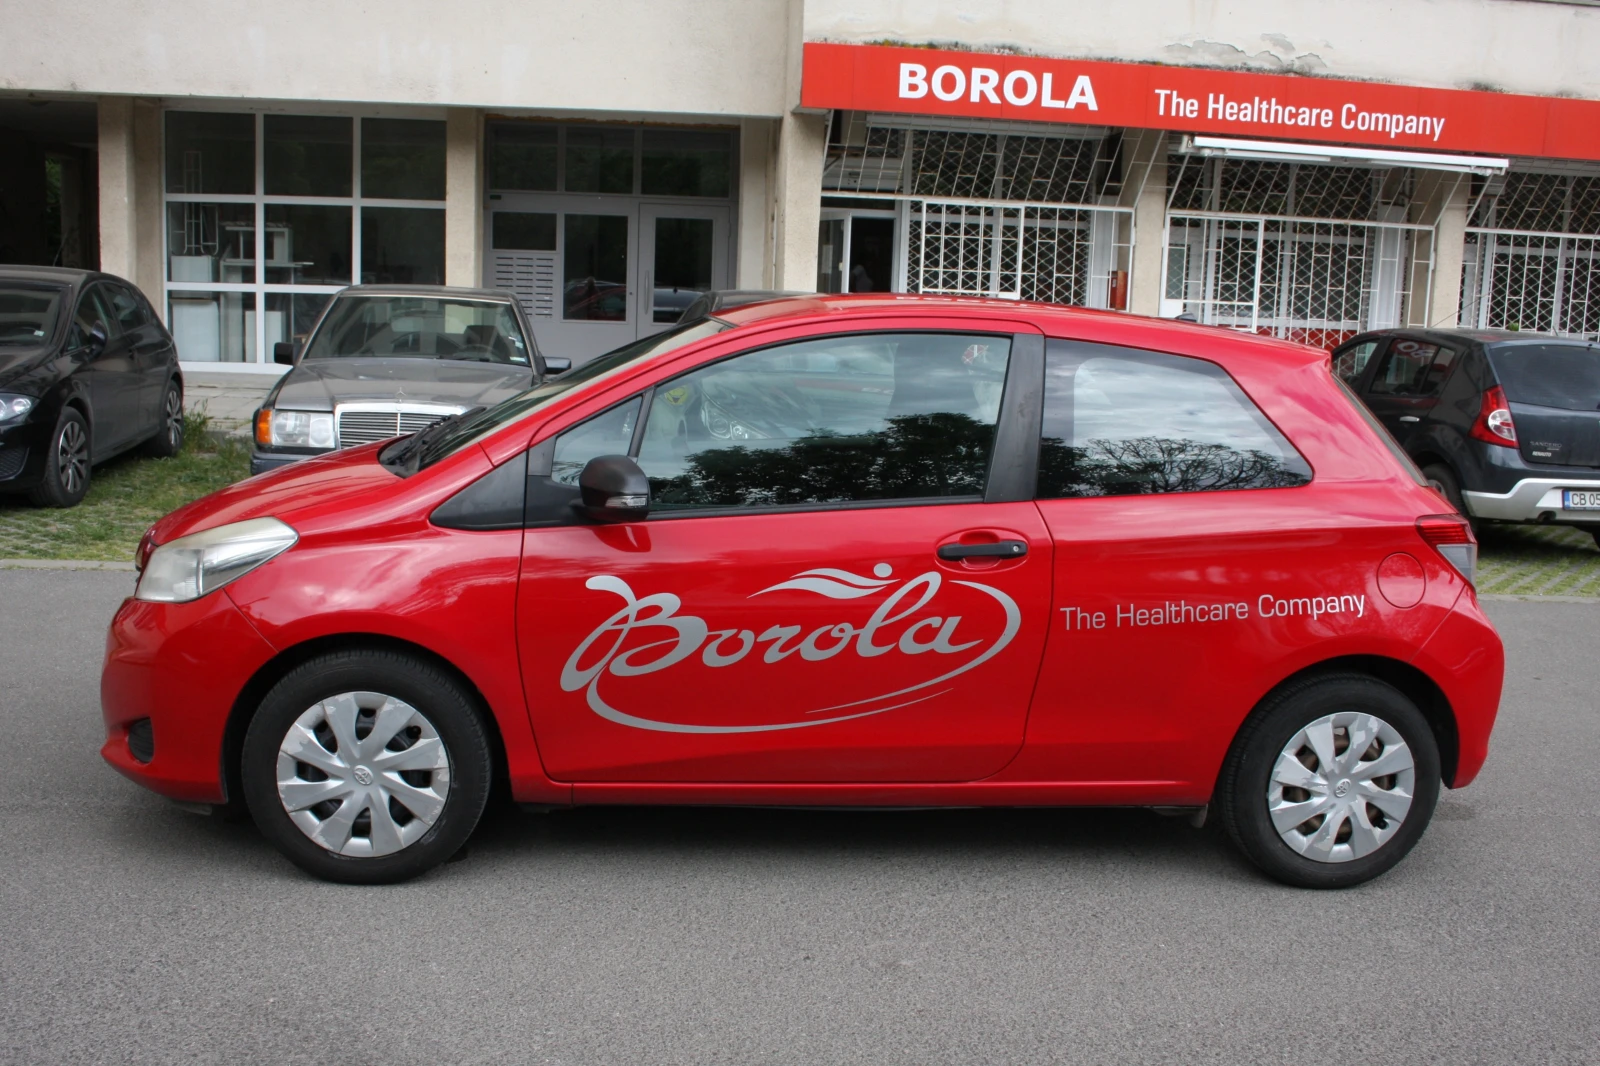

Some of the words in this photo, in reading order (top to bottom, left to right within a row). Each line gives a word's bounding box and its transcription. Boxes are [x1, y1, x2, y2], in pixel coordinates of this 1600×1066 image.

[898, 62, 1099, 111] BOROLA
[1154, 89, 1199, 118] The
[1206, 93, 1333, 128] Healthcare
[1341, 103, 1445, 141] Company
[1571, 493, 1587, 506] CB
[560, 571, 984, 692] Borola
[1060, 607, 1106, 630] The
[1116, 600, 1249, 627] Healthcare
[1258, 594, 1365, 620] Company
